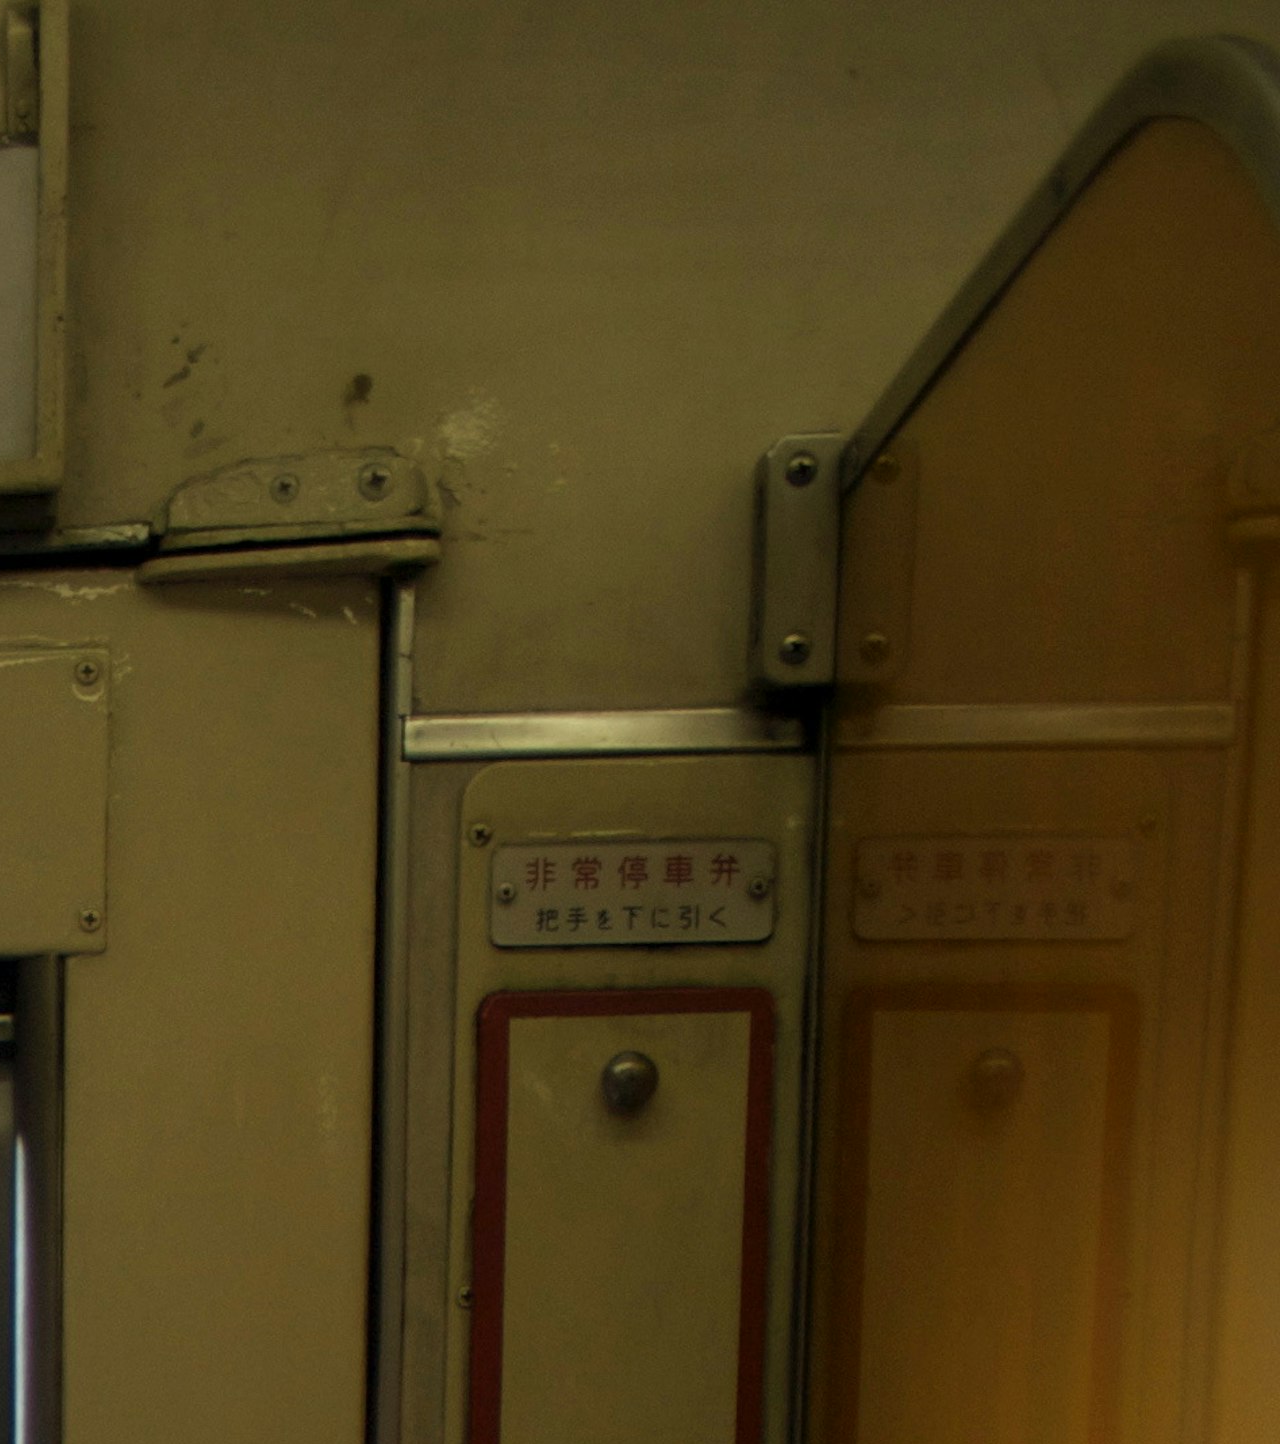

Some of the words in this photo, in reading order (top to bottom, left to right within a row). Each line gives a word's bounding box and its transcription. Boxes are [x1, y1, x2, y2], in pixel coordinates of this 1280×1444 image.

[524, 852, 742, 891] 非常停車弁
[536, 905, 727, 933] 把手を下に引く
